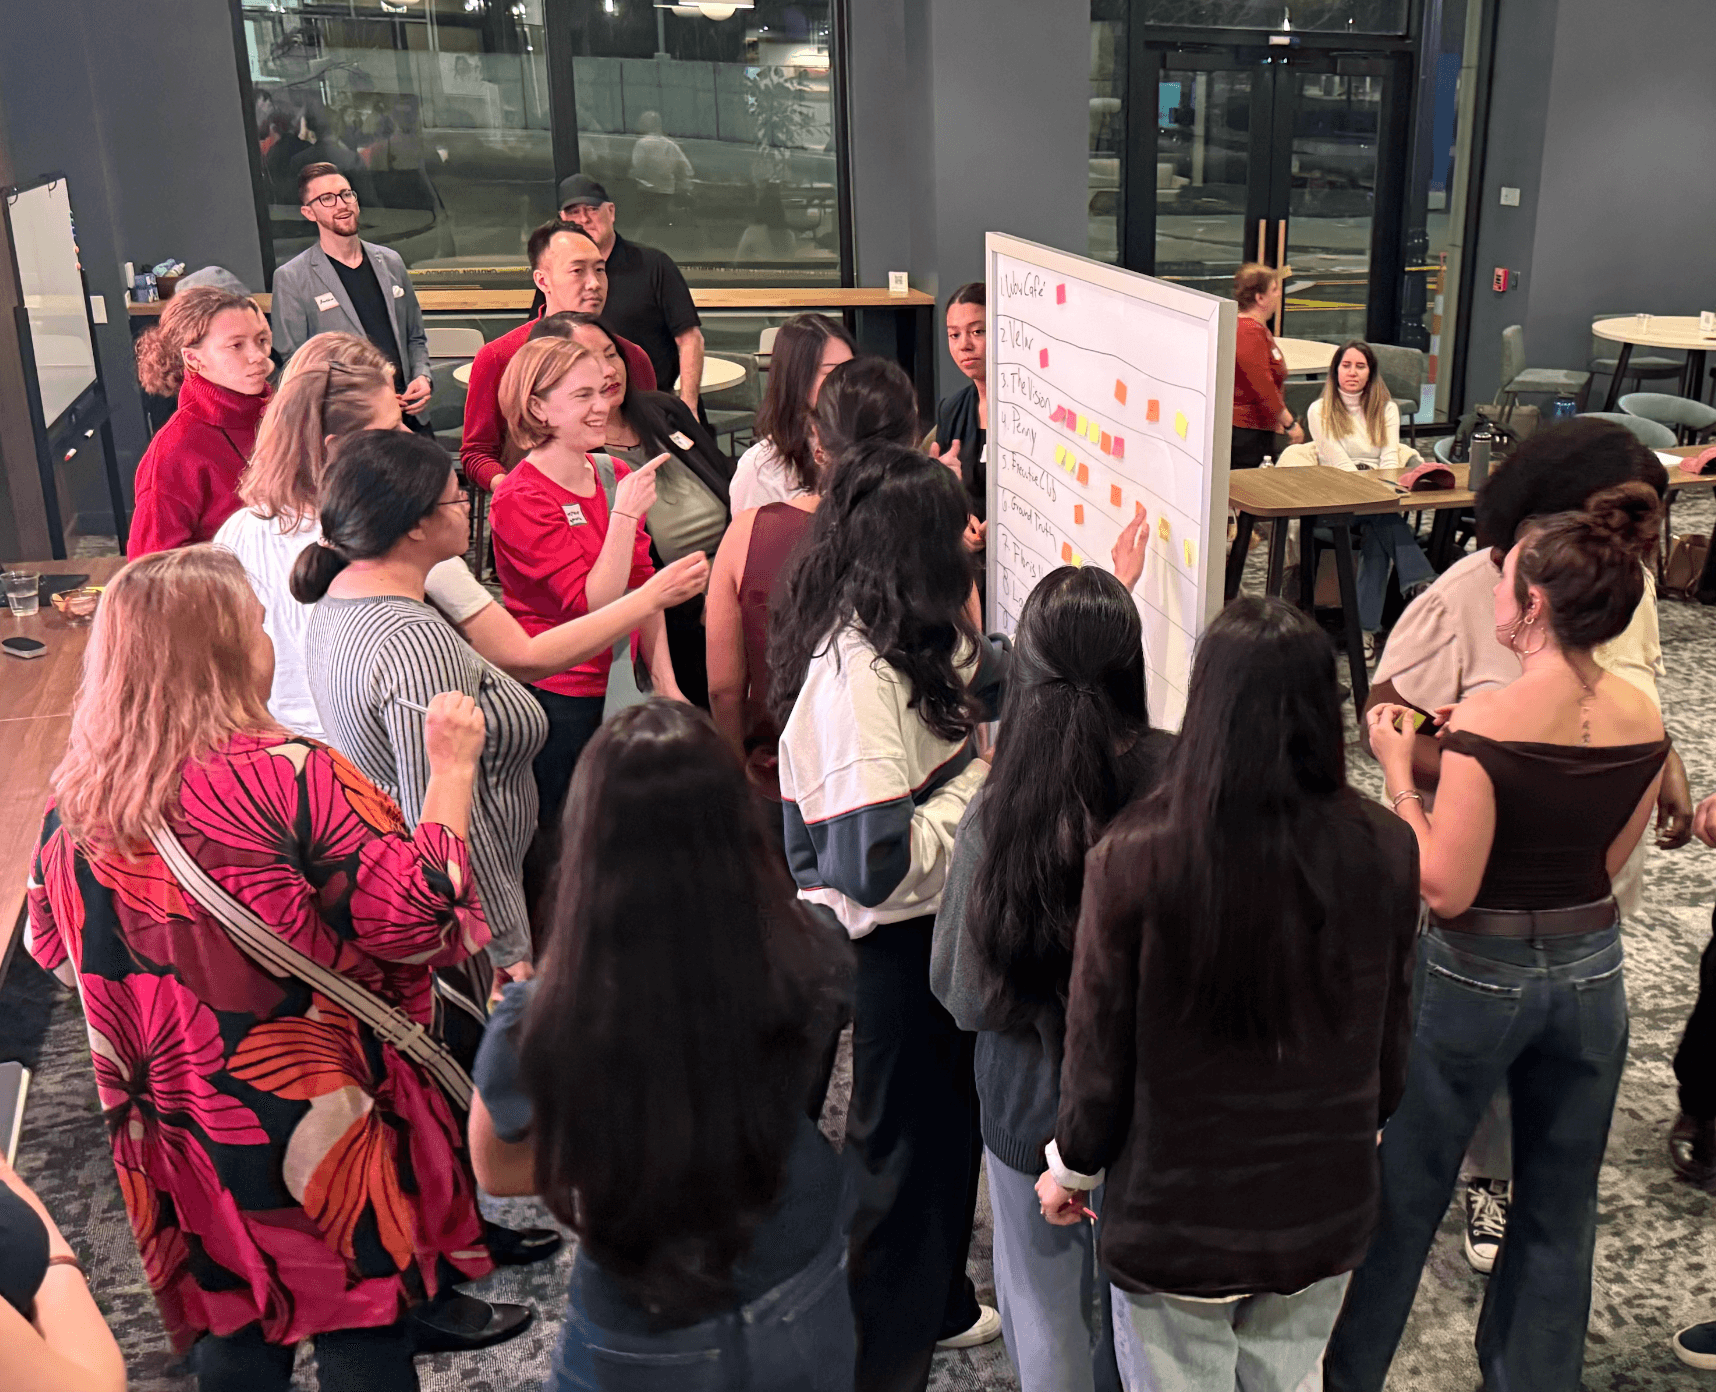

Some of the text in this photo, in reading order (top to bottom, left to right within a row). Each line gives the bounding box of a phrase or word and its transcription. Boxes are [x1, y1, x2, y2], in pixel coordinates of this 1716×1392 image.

[1000, 372, 1009, 388] 3.
[1011, 405, 1037, 457] Penny
[1010, 495, 1032, 525] Ground
[1034, 511, 1057, 553] Truth
